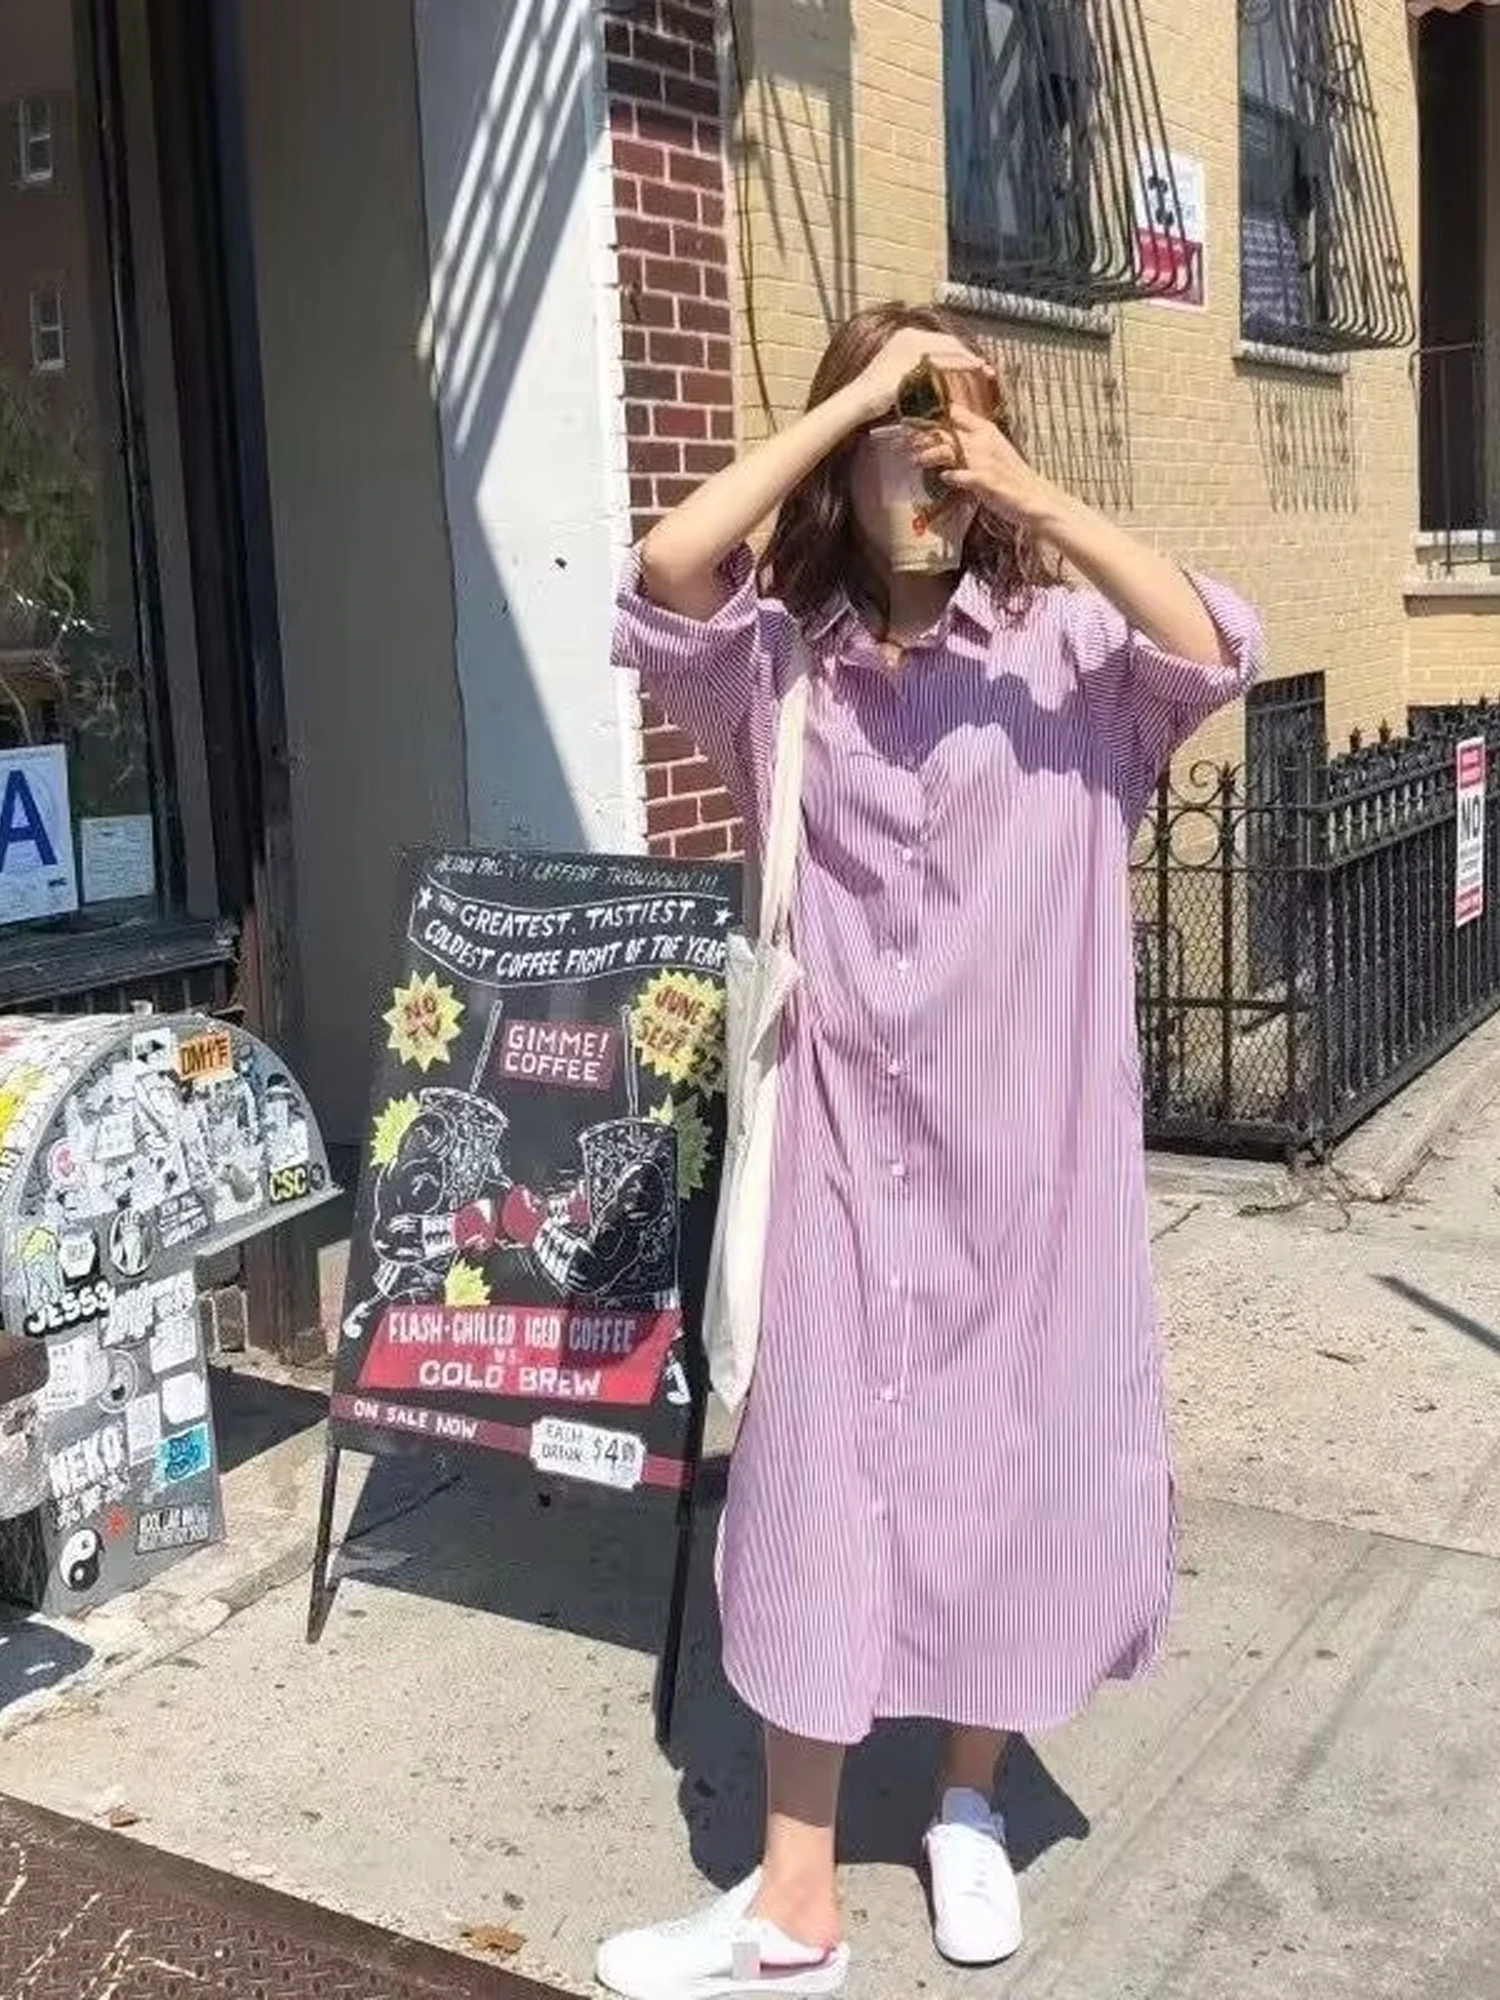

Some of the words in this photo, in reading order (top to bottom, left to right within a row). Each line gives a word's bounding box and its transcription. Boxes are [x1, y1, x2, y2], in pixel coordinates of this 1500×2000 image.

[0, 771, 57, 873] A
[424, 919, 495, 970] COLDEST
[496, 949, 561, 978] COFFEE
[564, 941, 622, 975] FIGHT
[624, 937, 647, 964] OF
[650, 934, 684, 961] THE
[509, 1024, 610, 1059] GIMME!
[505, 1051, 601, 1081] COFFEE
[270, 1167, 306, 1201] CSC
[569, 1316, 637, 1354] COFFEE
[419, 1359, 504, 1389] COLD
[519, 1366, 602, 1397] BREW
[353, 1399, 379, 1419] ON
[387, 1406, 428, 1429] SALE
[436, 1416, 477, 1439] NOW
